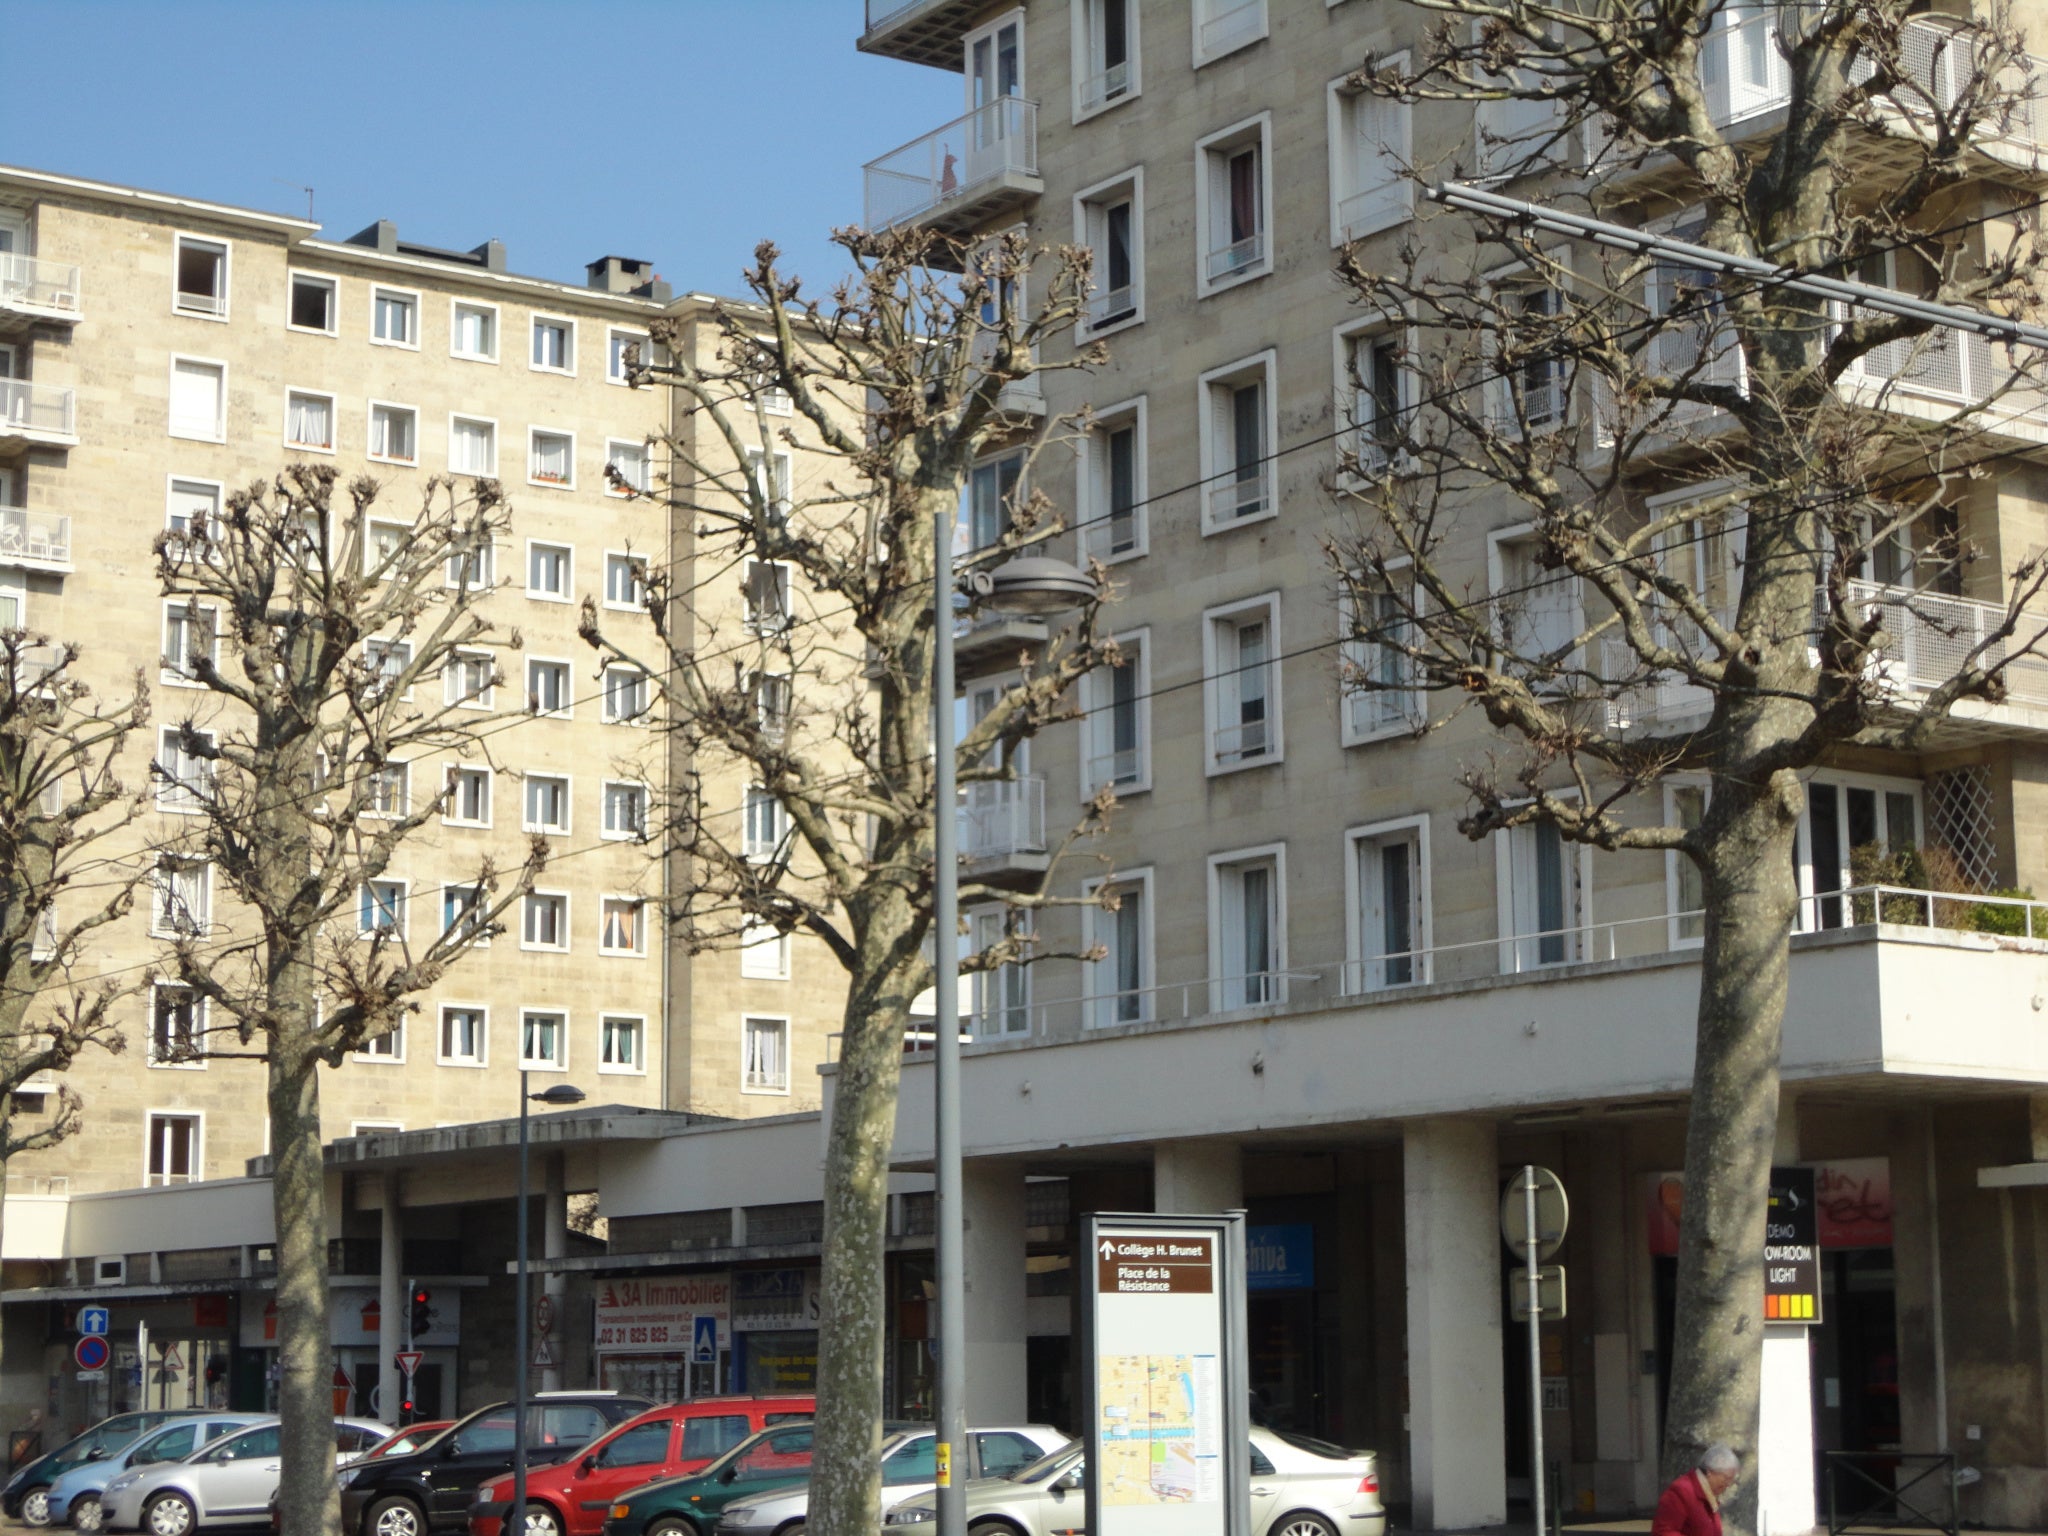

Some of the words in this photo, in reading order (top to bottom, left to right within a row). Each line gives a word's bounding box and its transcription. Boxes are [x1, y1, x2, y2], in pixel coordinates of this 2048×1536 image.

[1767, 1223, 1796, 1239] DEMO
[1117, 1244, 1155, 1258] Collège
[1156, 1245, 1168, 1256] H.
[1169, 1245, 1203, 1257] Brunet
[1764, 1245, 1812, 1261] OW-ROOM
[1117, 1267, 1144, 1279] Place
[1145, 1267, 1159, 1279] de
[1160, 1267, 1170, 1279] la
[1769, 1267, 1797, 1284] LIGHT
[621, 1281, 641, 1307] 3A
[646, 1279, 729, 1306] Immobilier
[1118, 1280, 1170, 1292] Résistance
[601, 1327, 613, 1344] 02
[616, 1327, 626, 1344] 31
